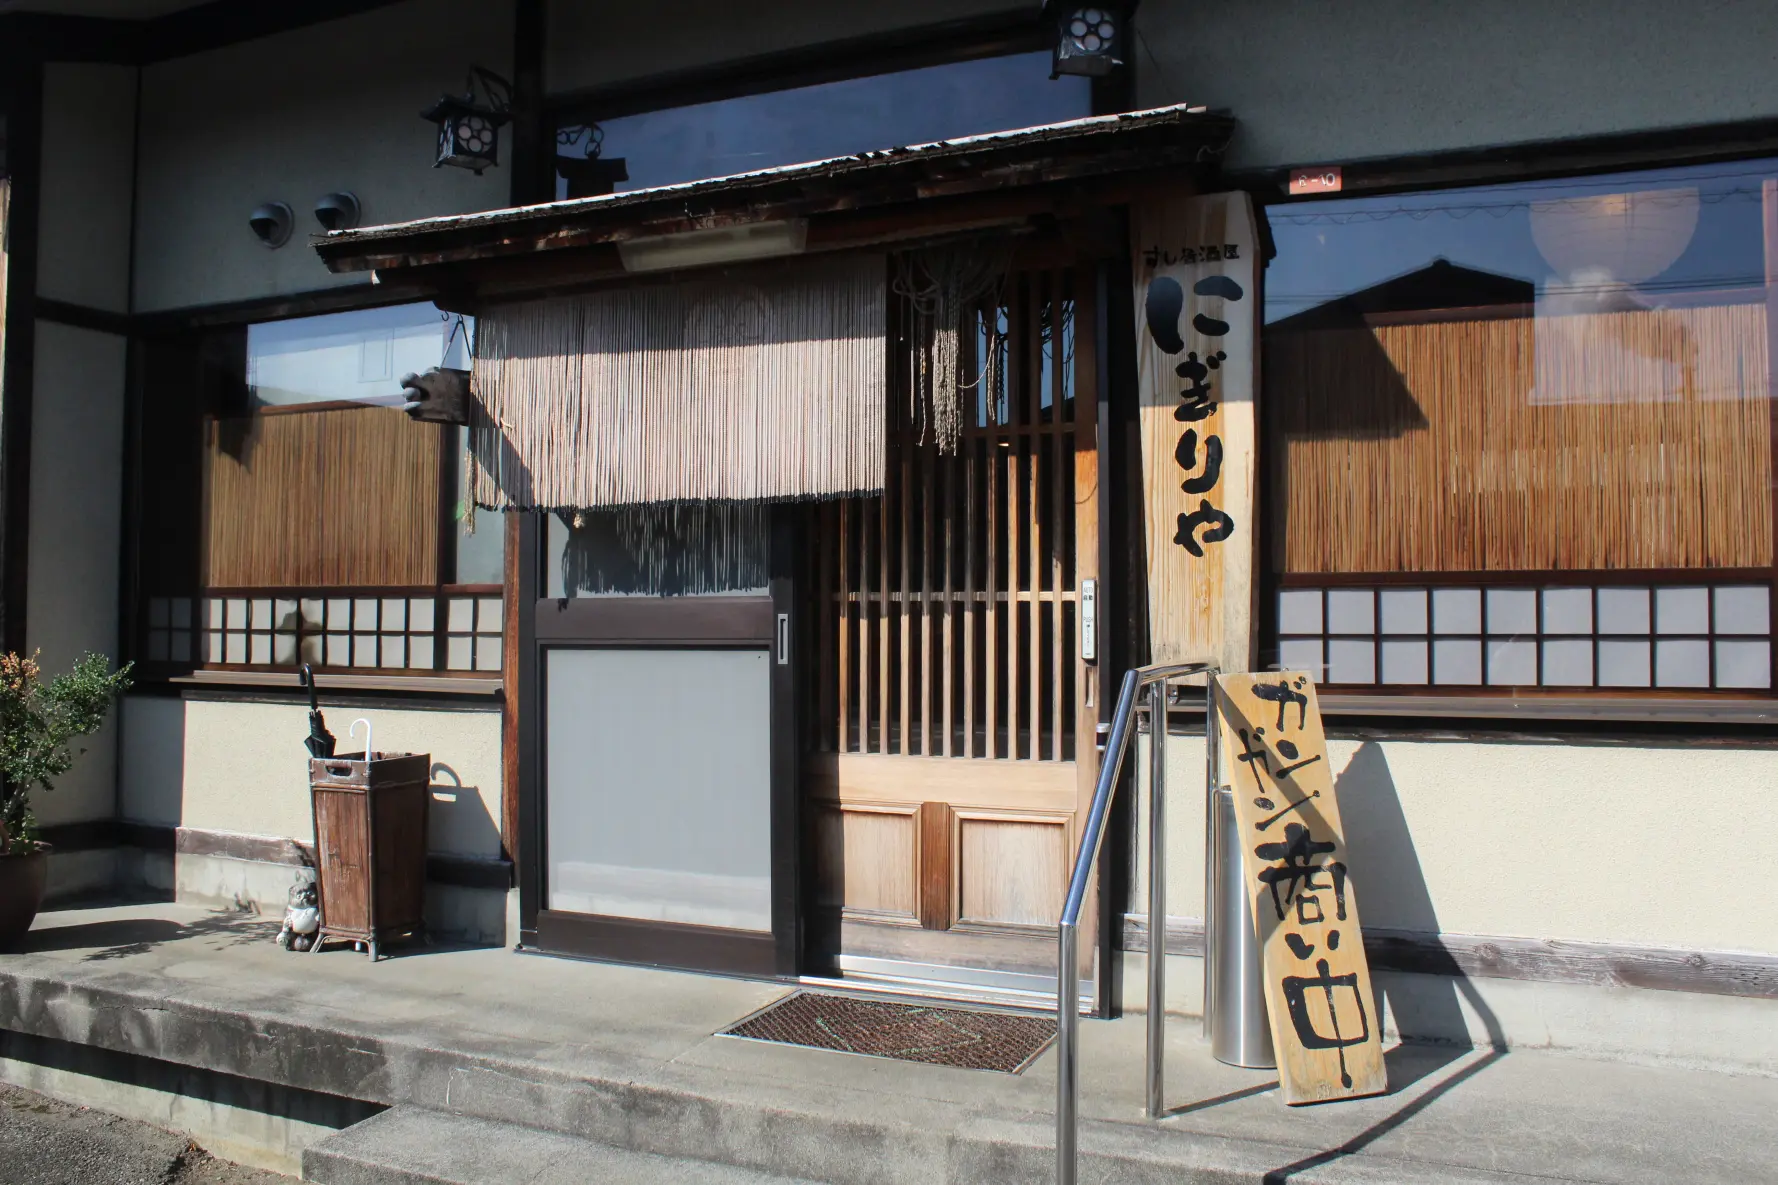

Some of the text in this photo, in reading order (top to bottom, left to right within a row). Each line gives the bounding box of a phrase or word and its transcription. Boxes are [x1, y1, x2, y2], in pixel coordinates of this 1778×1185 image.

[1142, 244, 1240, 268] すし居酒屋
[1146, 275, 1244, 557] にぎりや
